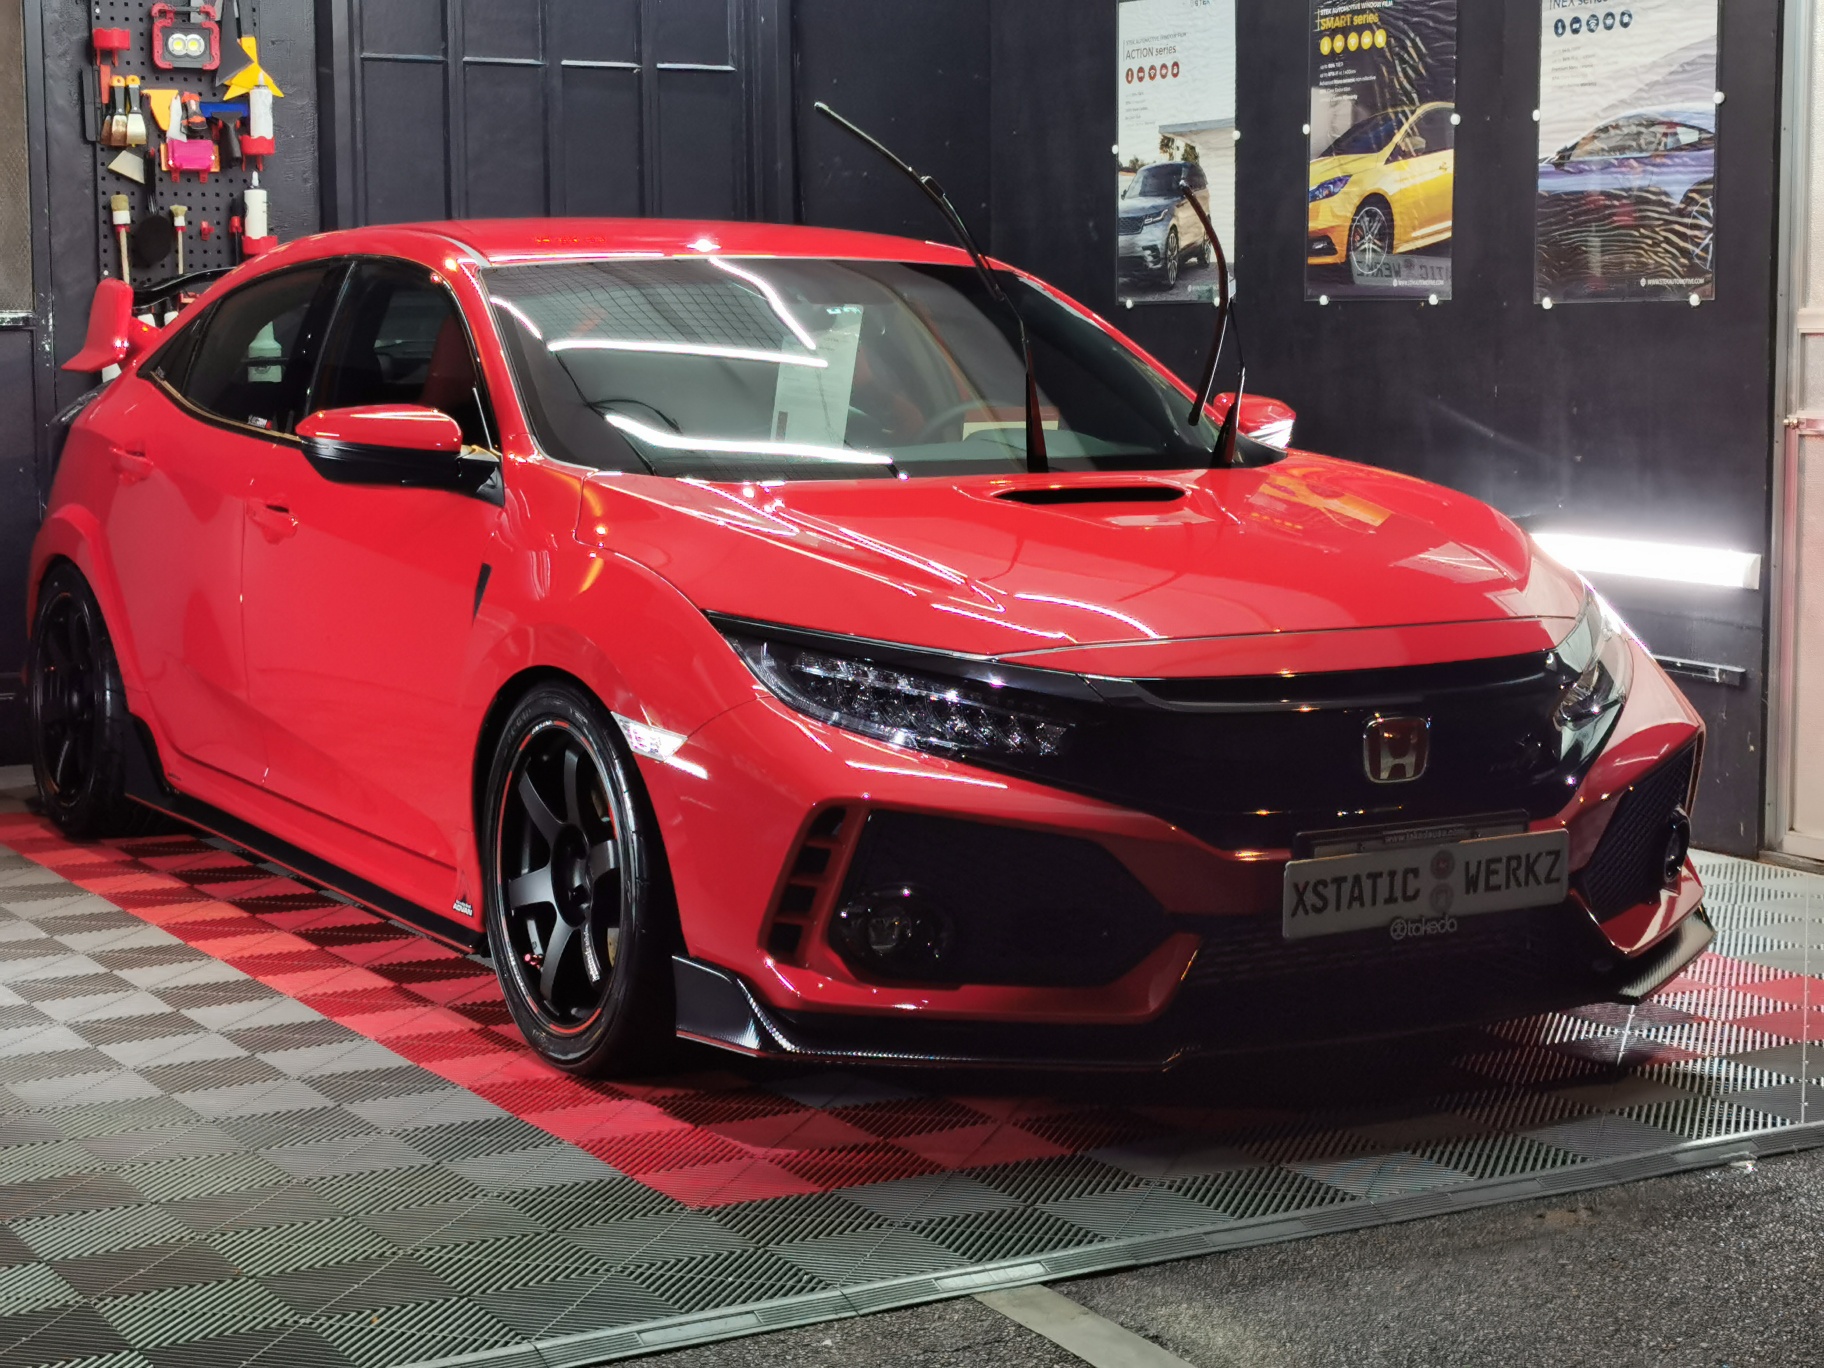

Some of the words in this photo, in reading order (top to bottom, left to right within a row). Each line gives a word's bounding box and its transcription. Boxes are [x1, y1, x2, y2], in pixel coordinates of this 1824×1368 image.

[1320, 8, 1332, 16] STEK
[1321, 14, 1352, 31] SMART
[1353, 11, 1379, 26] series
[1126, 46, 1154, 60] ACTION
[1155, 44, 1177, 57] series
[1290, 867, 1421, 918] XSTATIC
[1464, 849, 1562, 895] WERKZ
